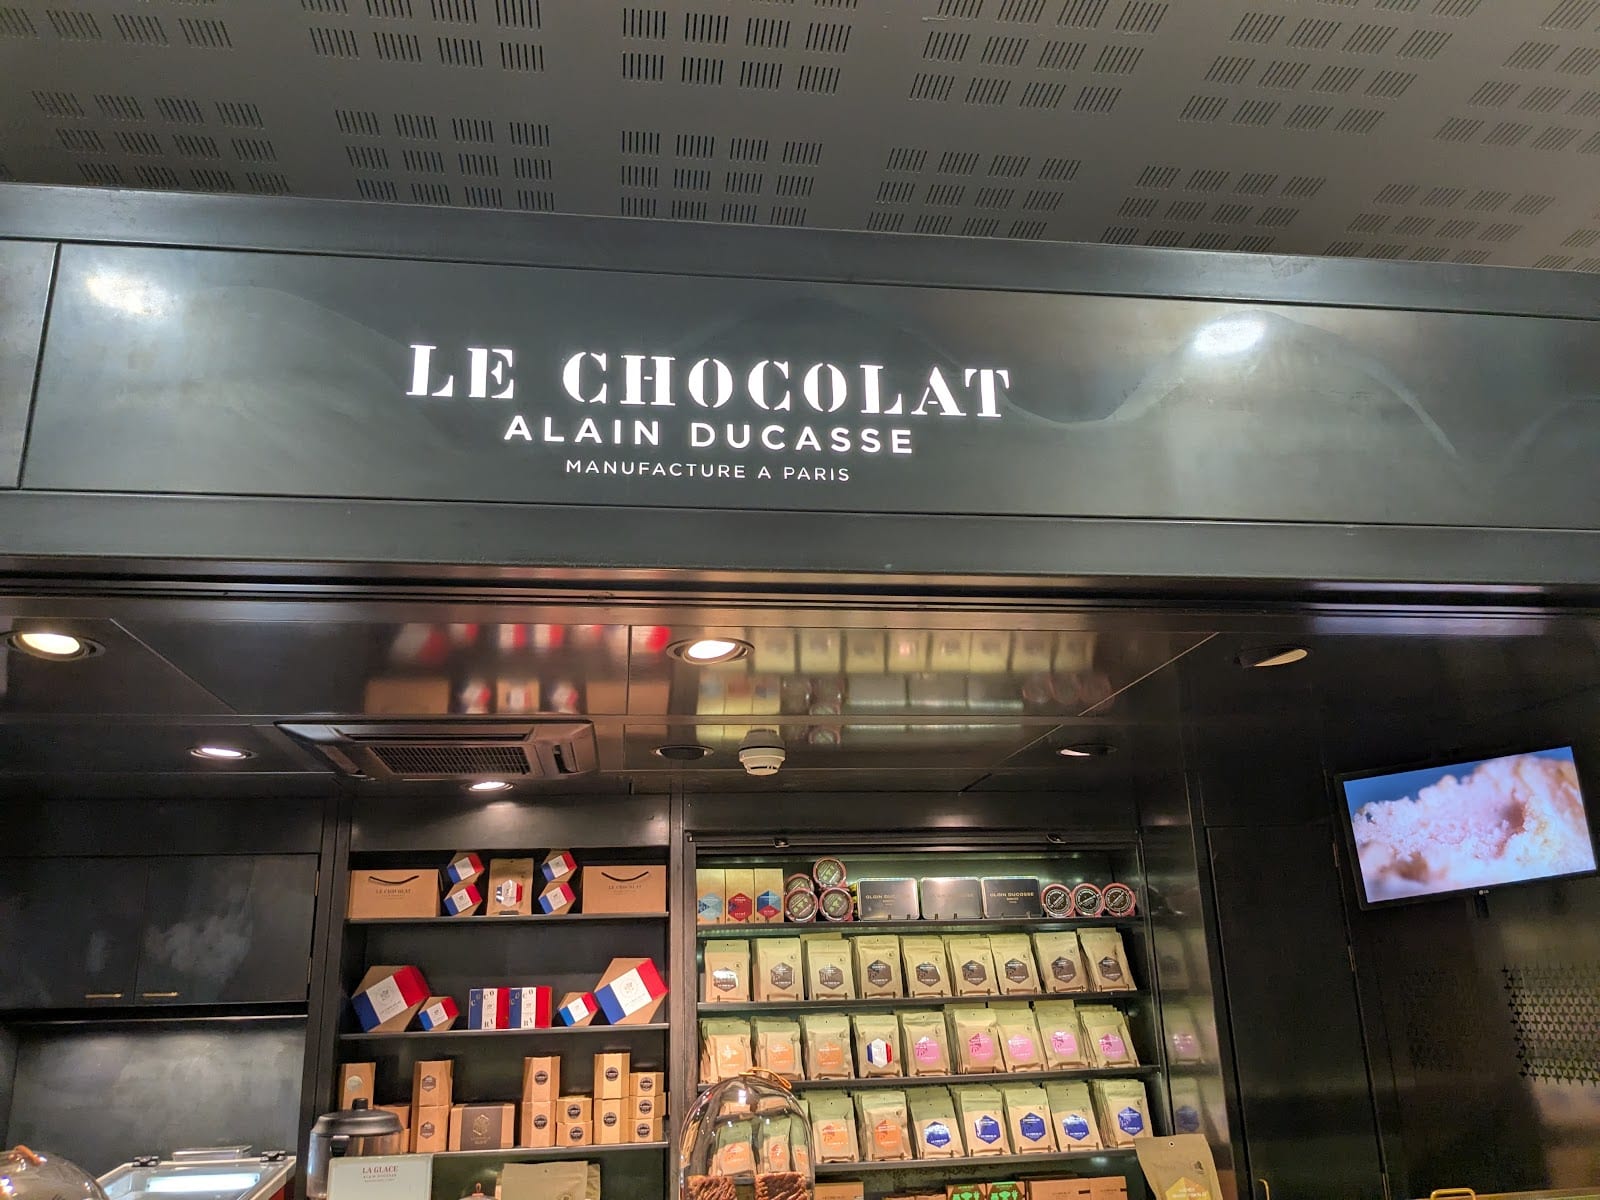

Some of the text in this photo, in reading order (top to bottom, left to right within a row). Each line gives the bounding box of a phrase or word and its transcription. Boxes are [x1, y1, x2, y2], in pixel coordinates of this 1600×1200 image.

[405, 343, 1010, 418] LE CHOCOLAT
[503, 414, 914, 456] ALAIN DUCASSE
[564, 458, 851, 483] MANUFACTURE A PARIS
